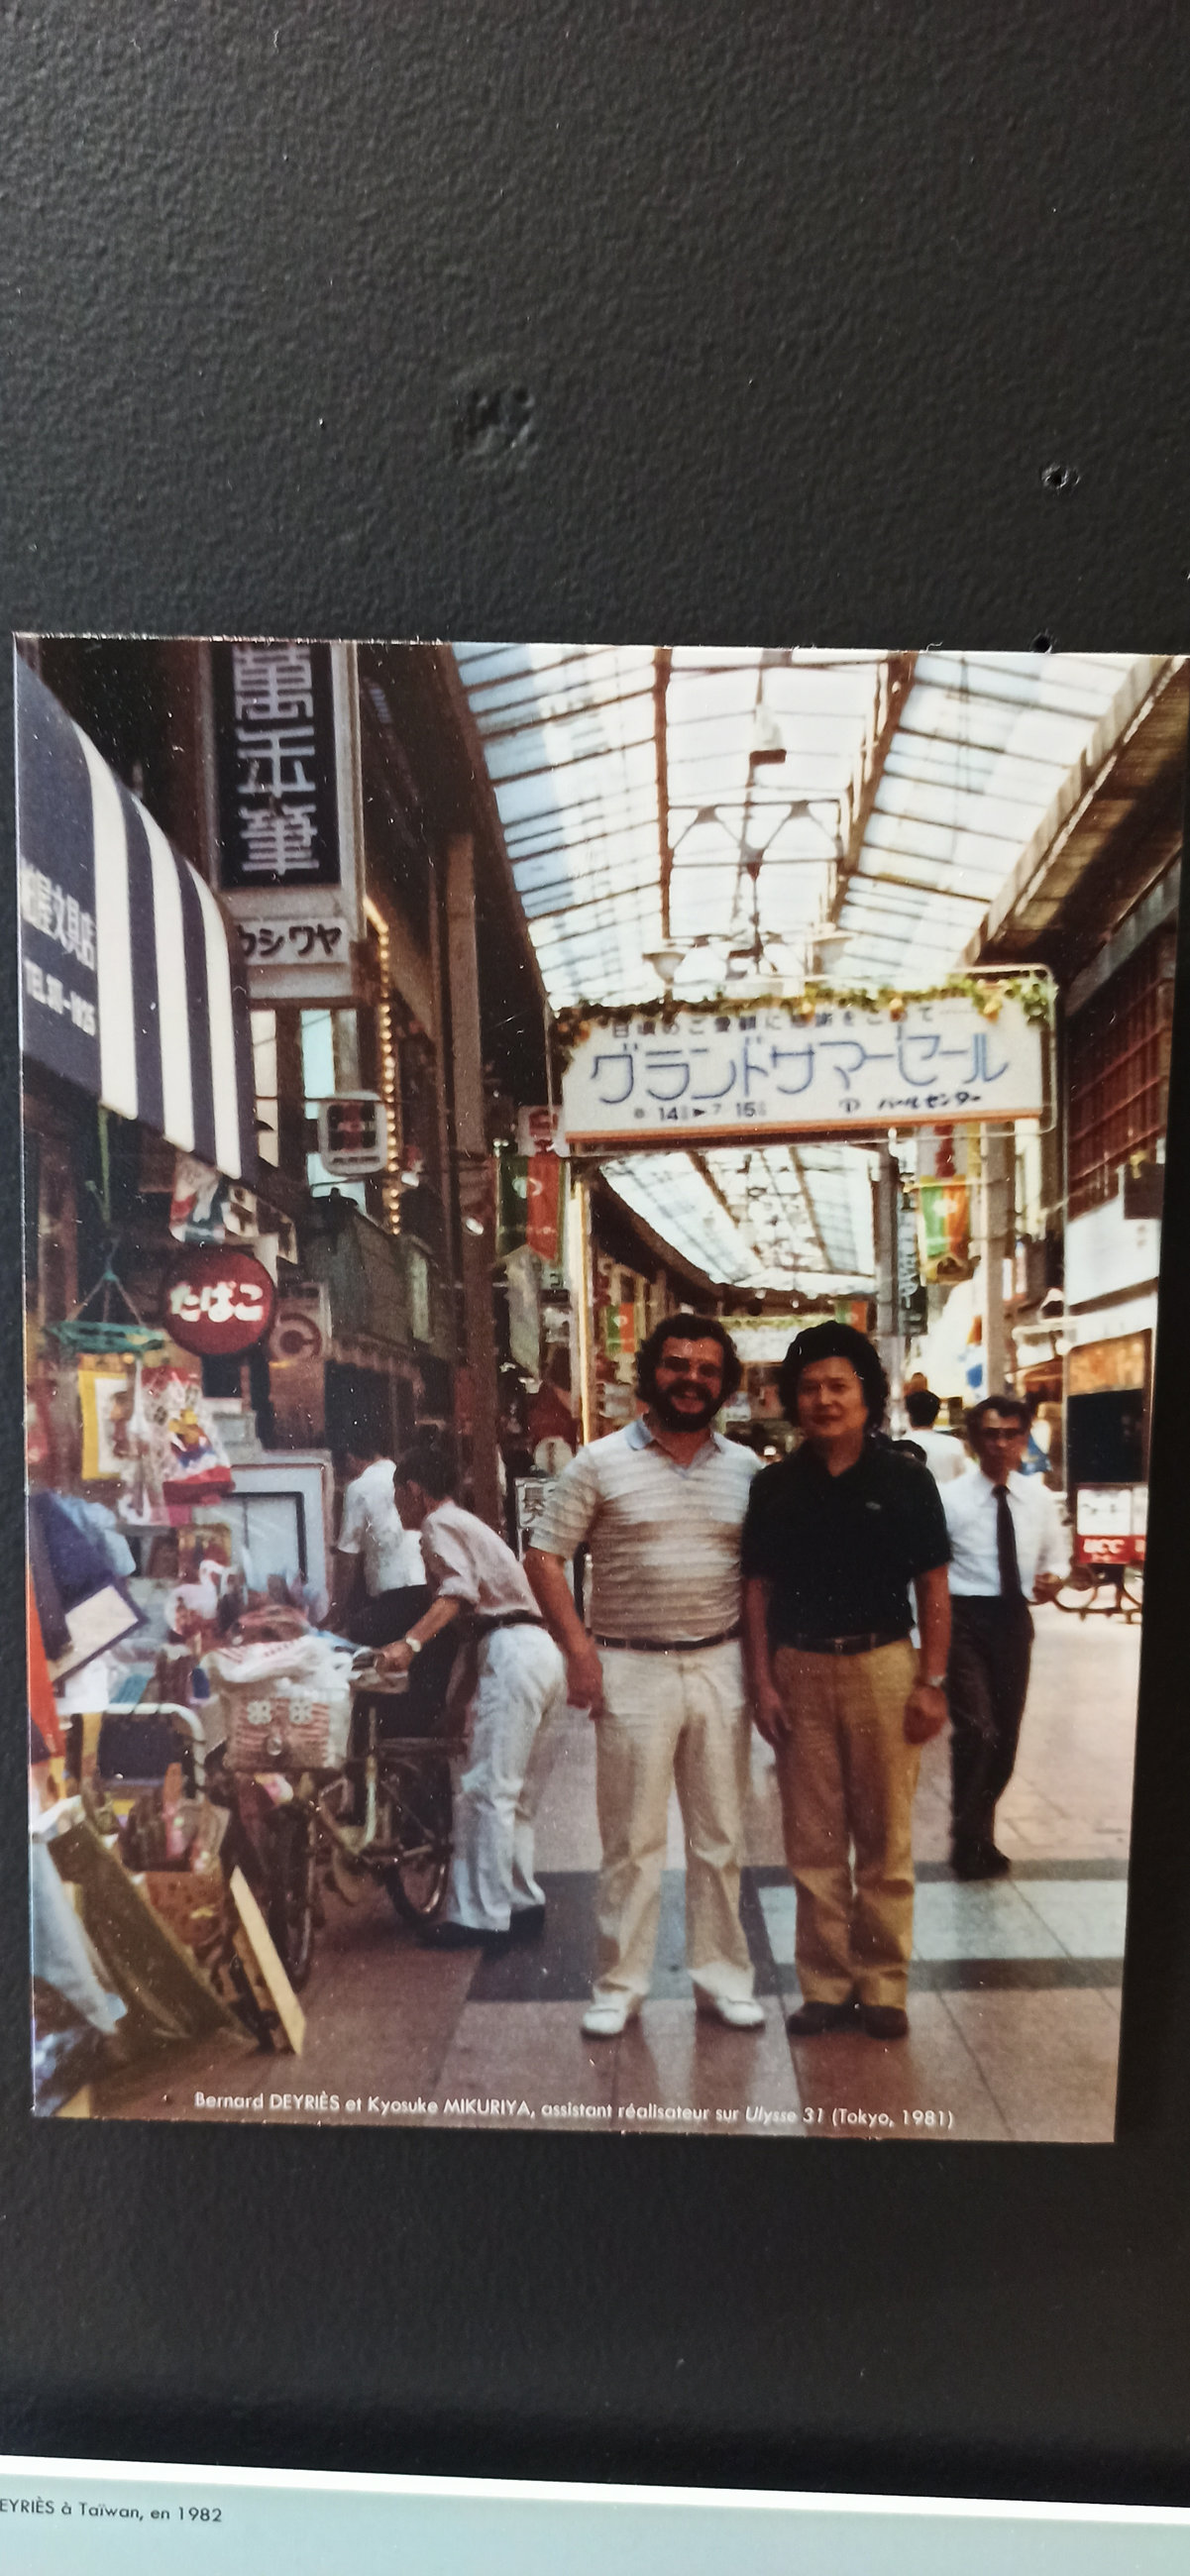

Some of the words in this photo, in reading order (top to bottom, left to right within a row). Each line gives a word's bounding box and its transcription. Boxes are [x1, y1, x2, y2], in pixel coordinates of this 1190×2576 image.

[591, 1023, 1010, 1105] グランドサマーセール
[169, 1280, 264, 1323] たばこ
[0, 2496, 54, 2515] EYRIÈS
[60, 2502, 72, 2516] à
[78, 2502, 144, 2522] Taïwan,
[150, 2509, 170, 2520] en
[178, 2507, 222, 2522] 1982
